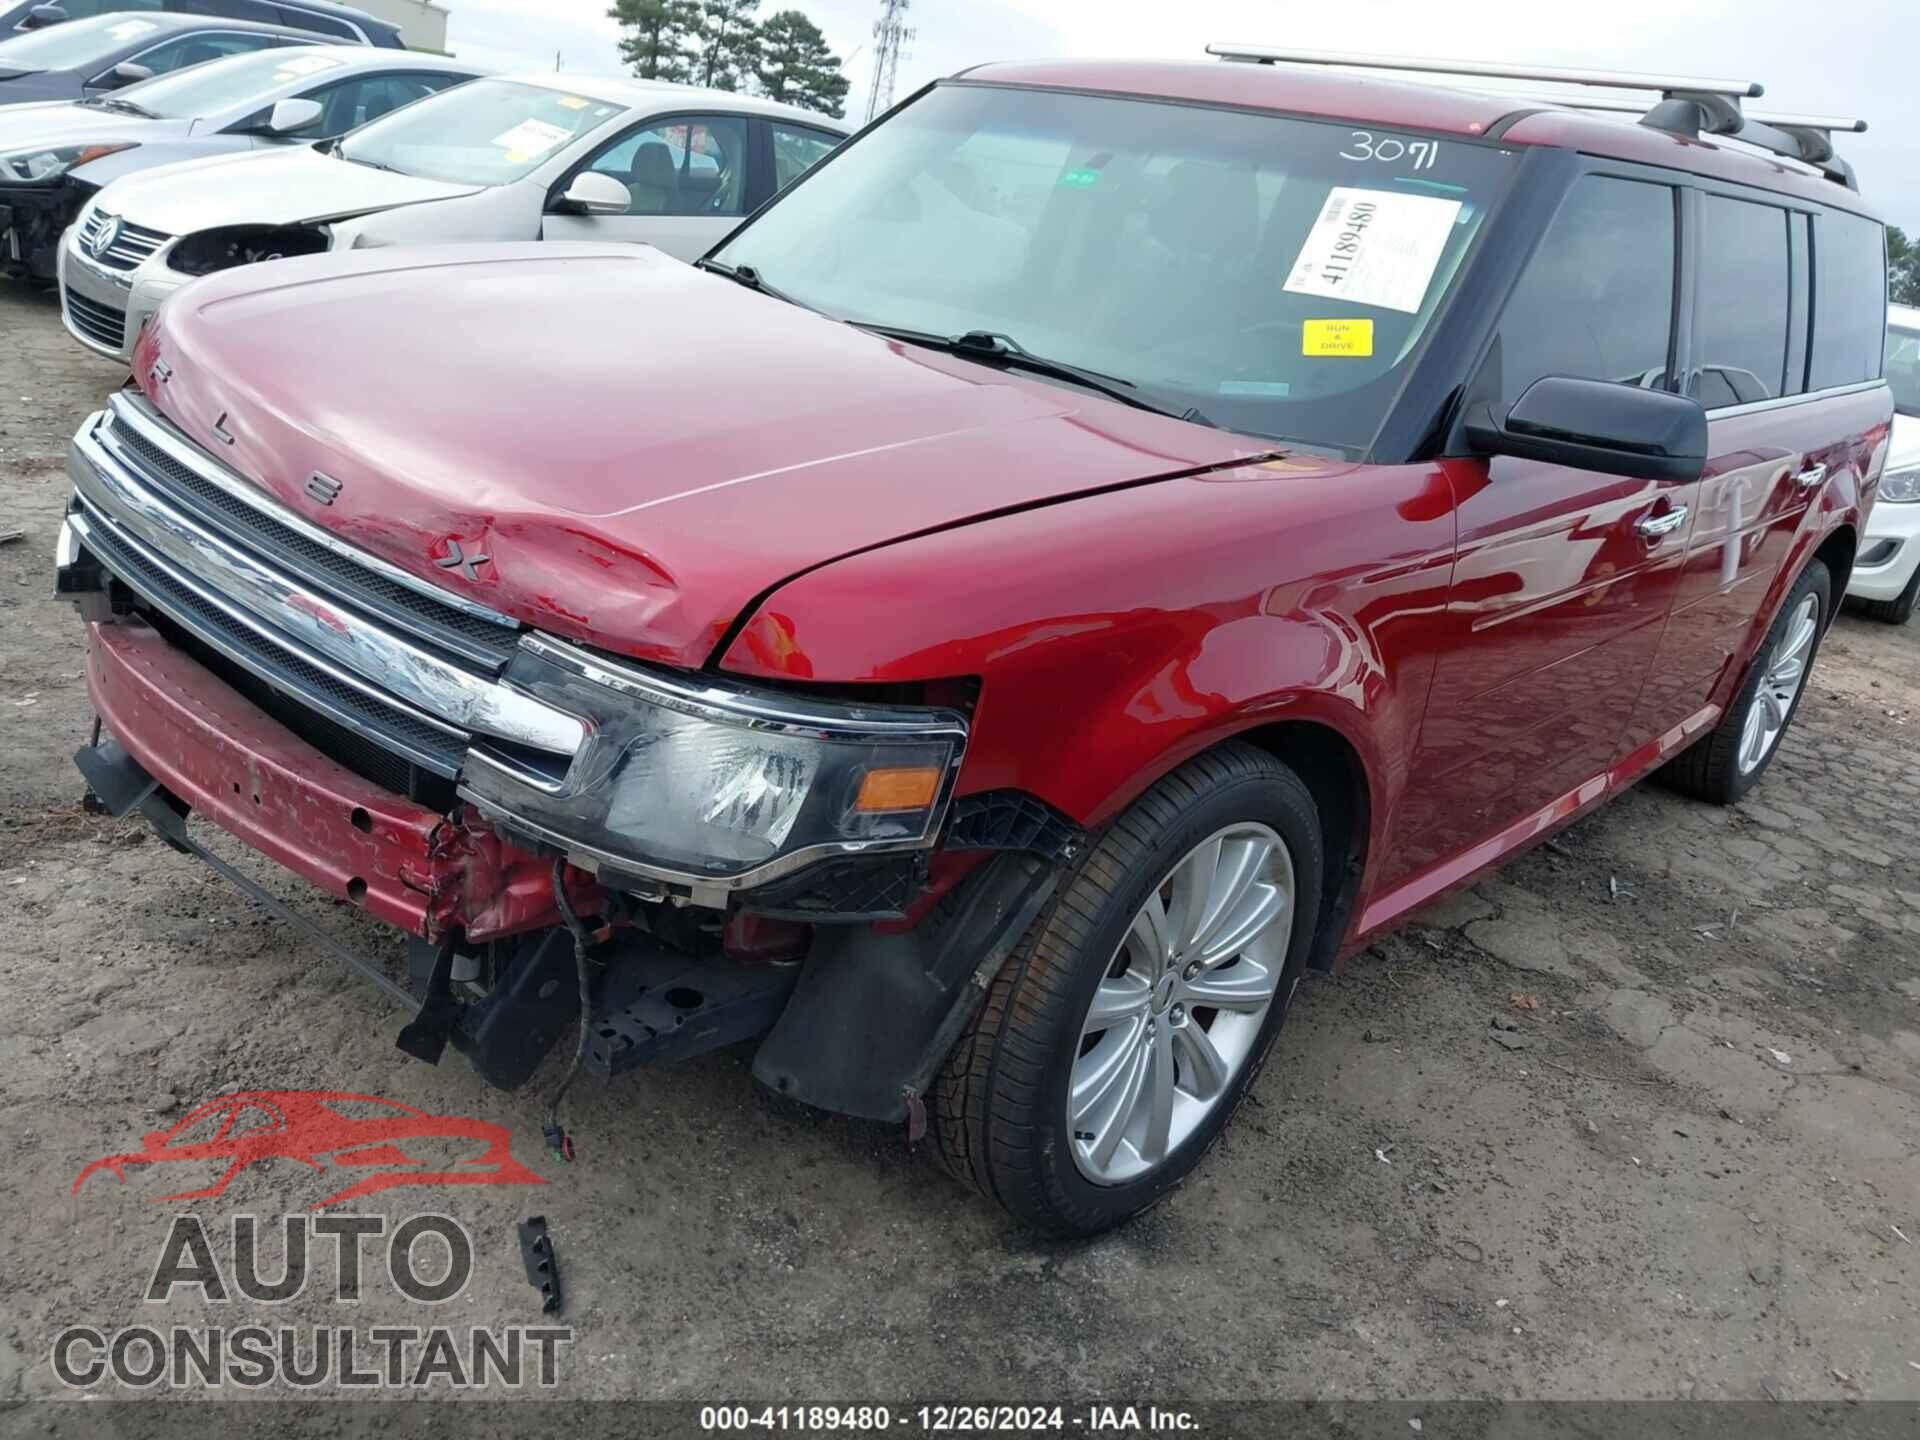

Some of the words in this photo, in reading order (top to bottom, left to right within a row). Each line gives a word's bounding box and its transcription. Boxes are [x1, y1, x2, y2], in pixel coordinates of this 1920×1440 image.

[1339, 131, 1438, 170] 3071
[1321, 202, 1376, 285] 41189480
[1320, 342, 1354, 350] DRIVE
